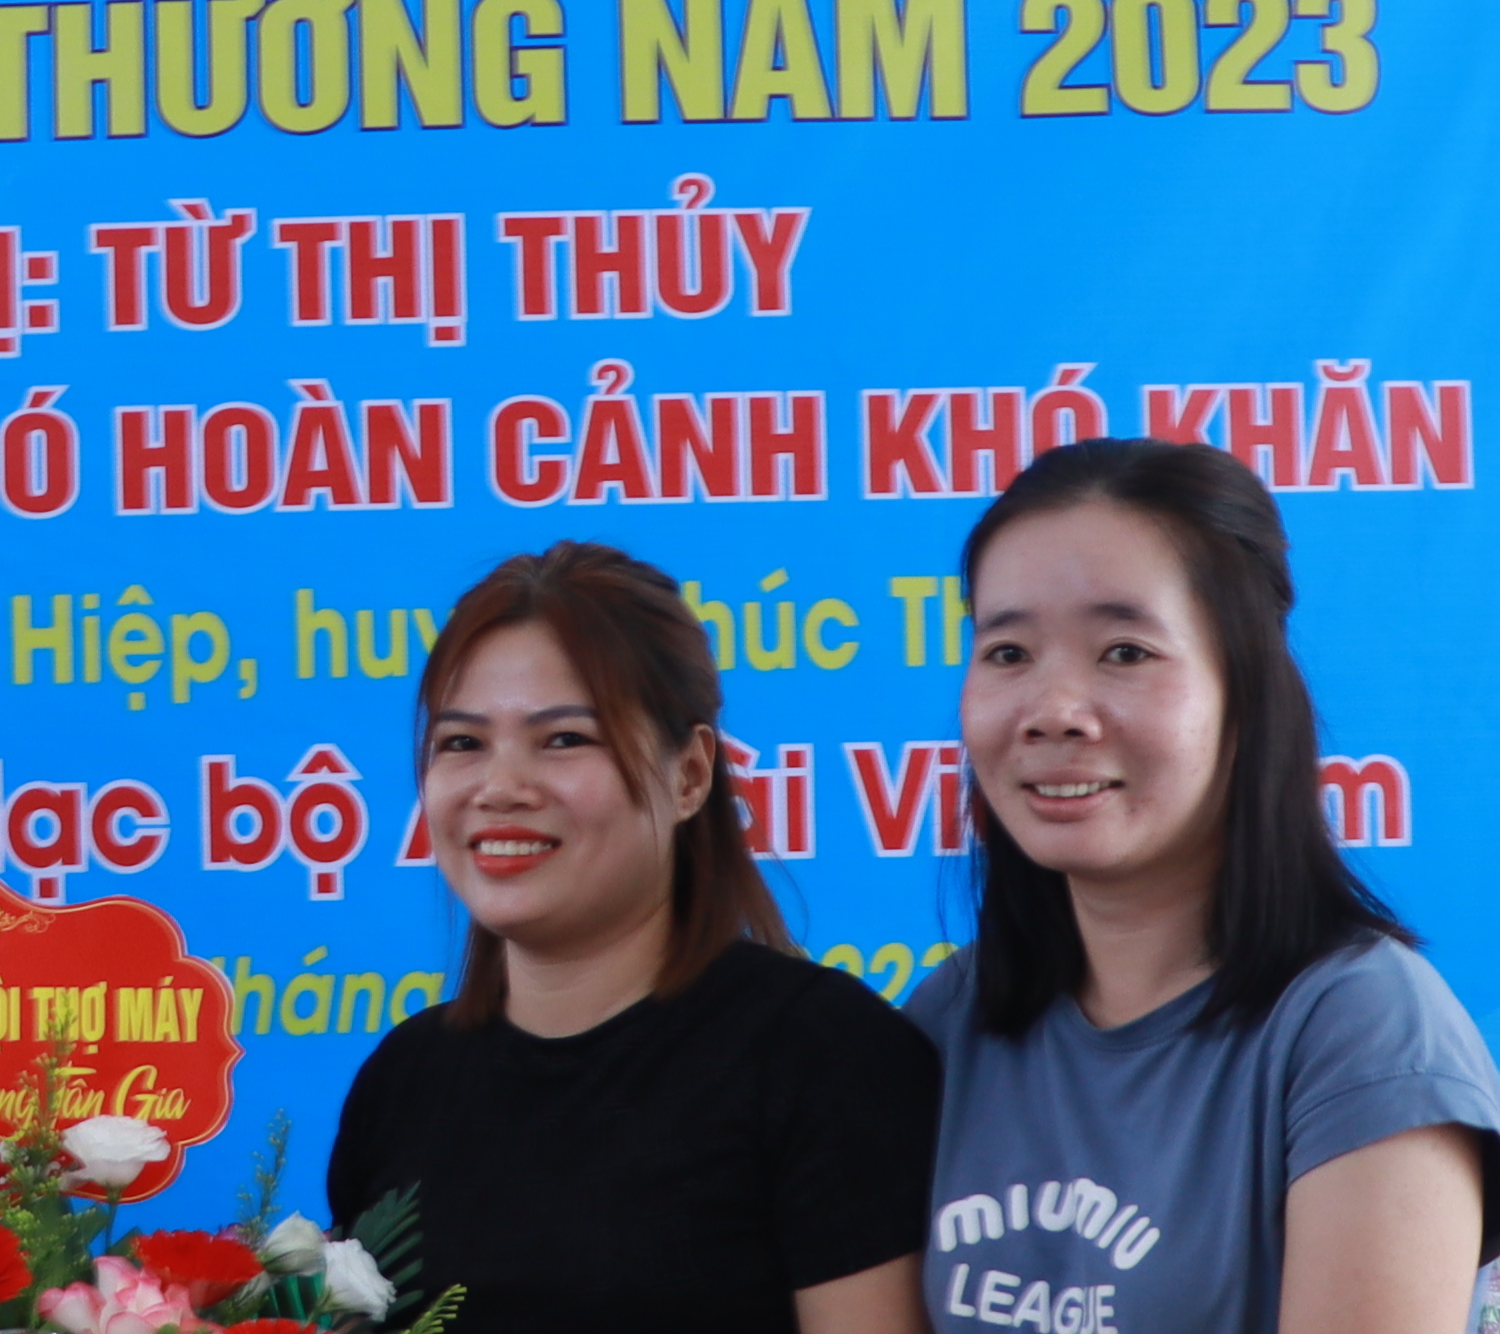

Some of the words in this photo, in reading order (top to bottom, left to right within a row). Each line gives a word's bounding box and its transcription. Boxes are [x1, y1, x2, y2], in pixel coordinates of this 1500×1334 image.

[91, 199, 255, 333] TỪ
[273, 212, 466, 347] THỊ
[498, 173, 810, 320] THỦY
[114, 380, 453, 515] HOÀN
[488, 358, 827, 507] CẢNH
[12, 584, 260, 710] Hiệp,
[680, 568, 858, 671] húc
[202, 742, 368, 901] bộ
[117, 976, 204, 1043] MÁY
[115, 1064, 190, 1122] Gia
